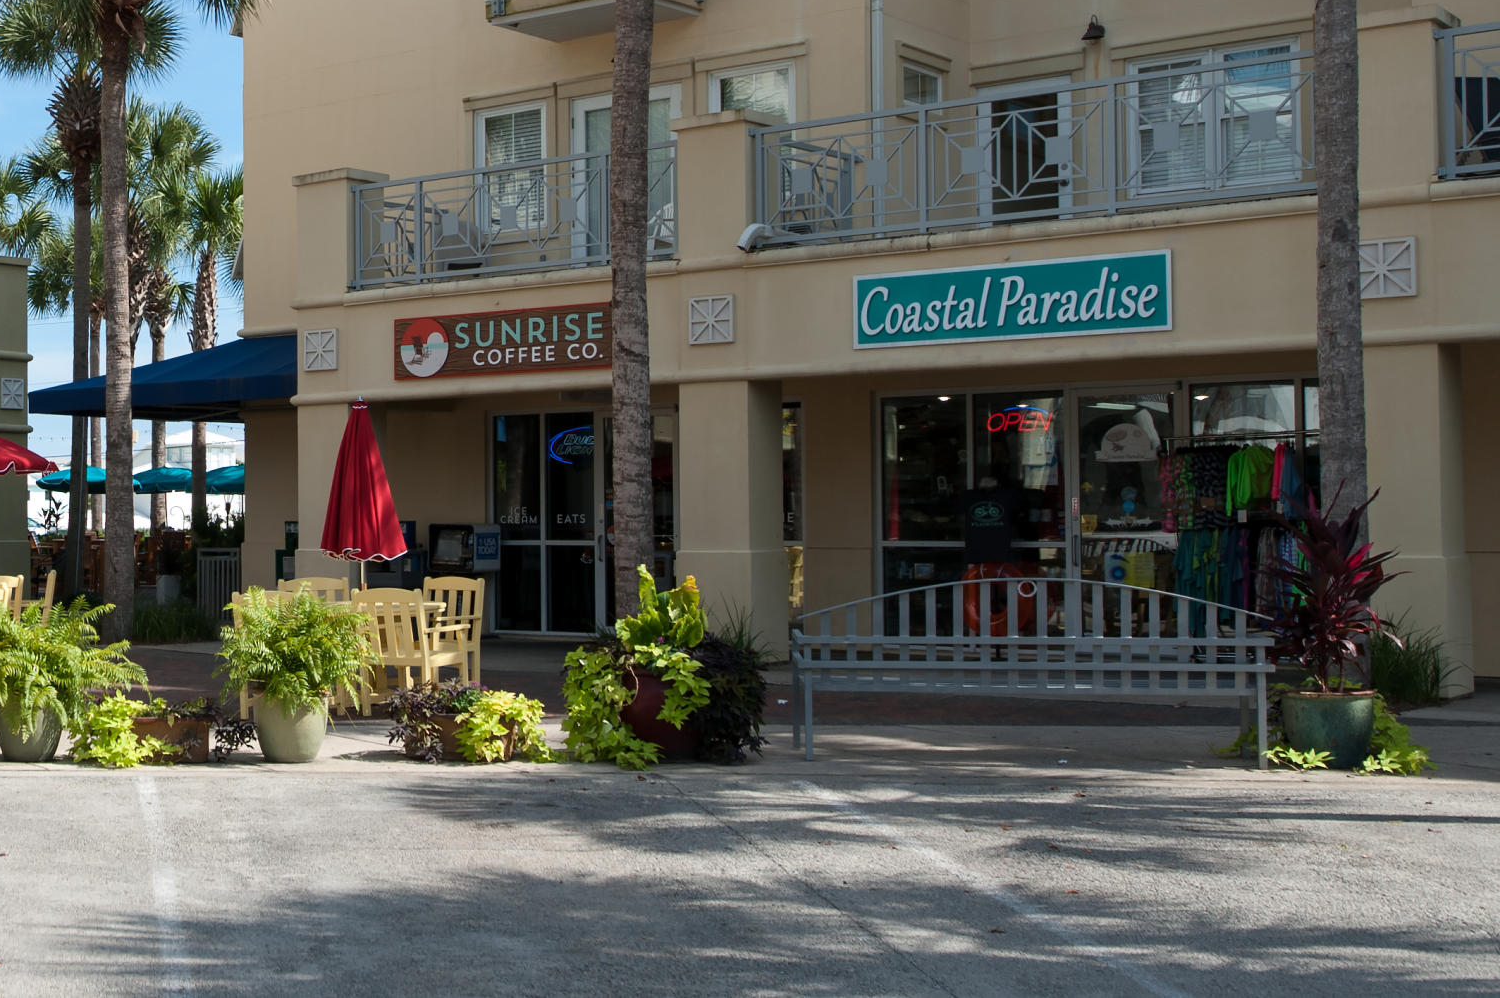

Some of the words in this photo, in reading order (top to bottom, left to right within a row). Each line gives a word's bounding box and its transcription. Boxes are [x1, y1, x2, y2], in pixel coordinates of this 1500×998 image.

[860, 276, 992, 336] Coastal
[997, 266, 1159, 327] Paradise
[454, 312, 604, 349] SUNRISE
[472, 345, 556, 366] COFFEE
[567, 342, 604, 360] CO.
[987, 412, 1053, 432] OPEN
[510, 506, 527, 516] ICE
[500, 515, 538, 524] CREAM
[556, 514, 586, 524] EATS
[483, 537, 497, 546] USA
[477, 546, 497, 555] TODAY
